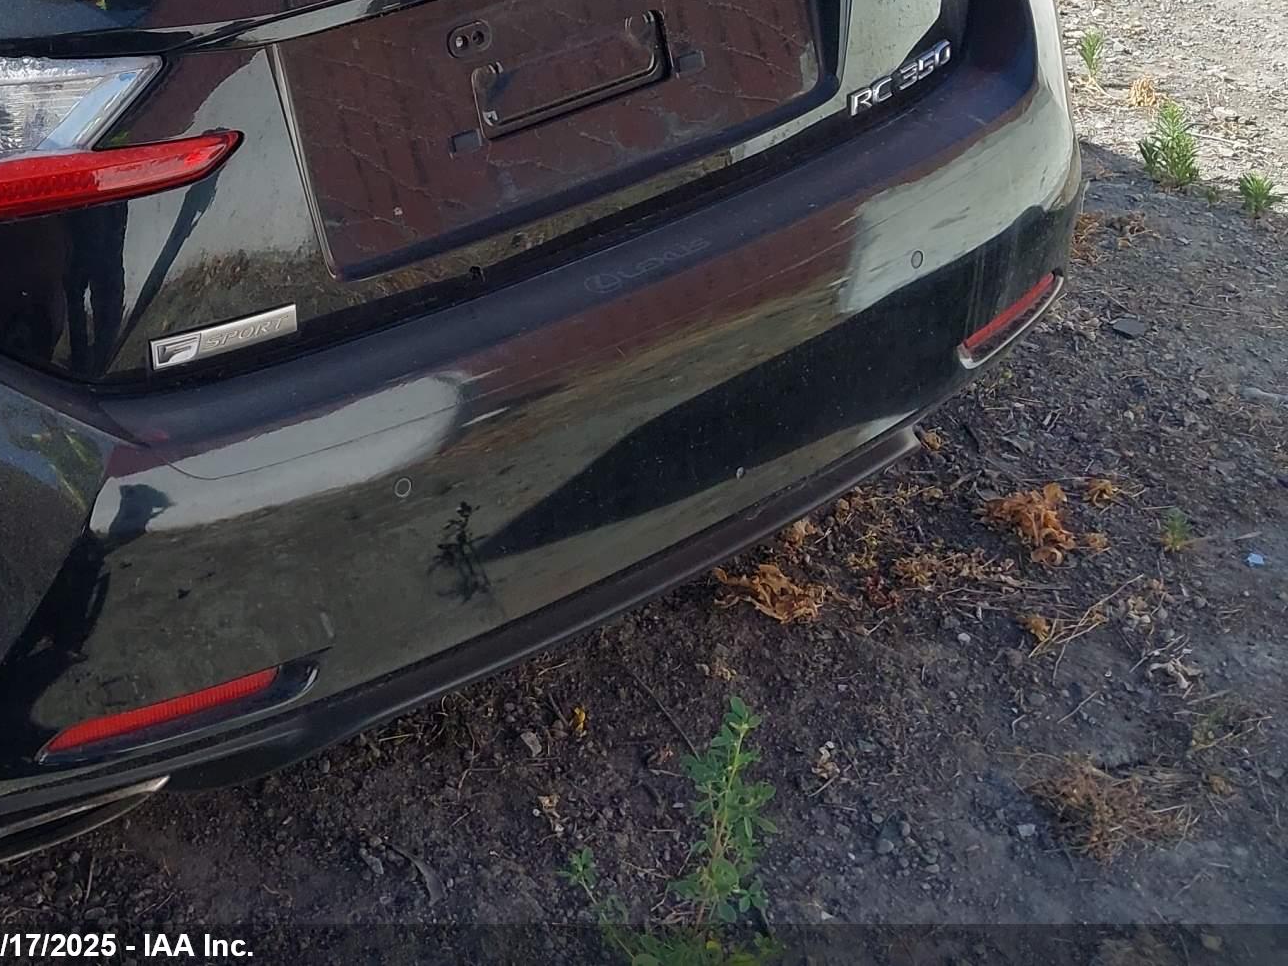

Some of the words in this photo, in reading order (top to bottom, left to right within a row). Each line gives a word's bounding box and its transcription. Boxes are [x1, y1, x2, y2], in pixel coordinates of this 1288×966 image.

[847, 75, 893, 117] RC
[898, 39, 952, 91] 350
[205, 314, 289, 348] SPORT
